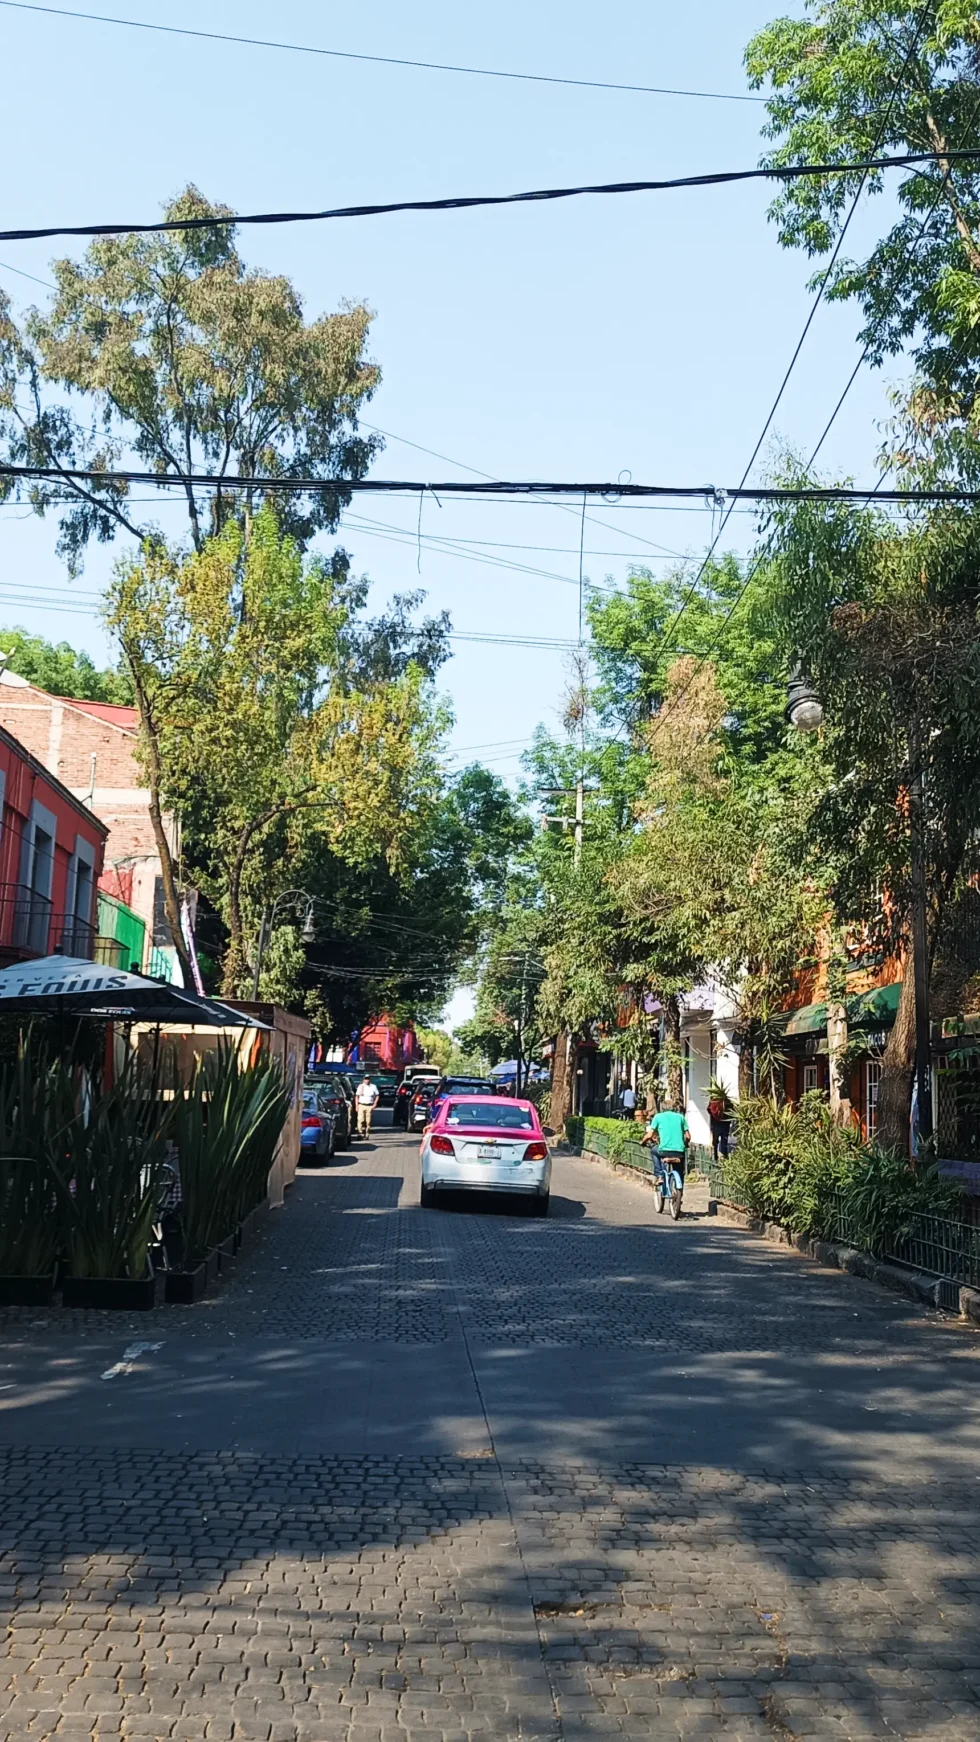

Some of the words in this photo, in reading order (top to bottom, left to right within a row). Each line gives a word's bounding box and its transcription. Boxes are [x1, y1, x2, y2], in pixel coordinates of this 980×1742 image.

[3, 974, 82, 983] ERVEZA
[18, 976, 128, 995] EQUIS
[867, 1032, 885, 1045] TACOS
